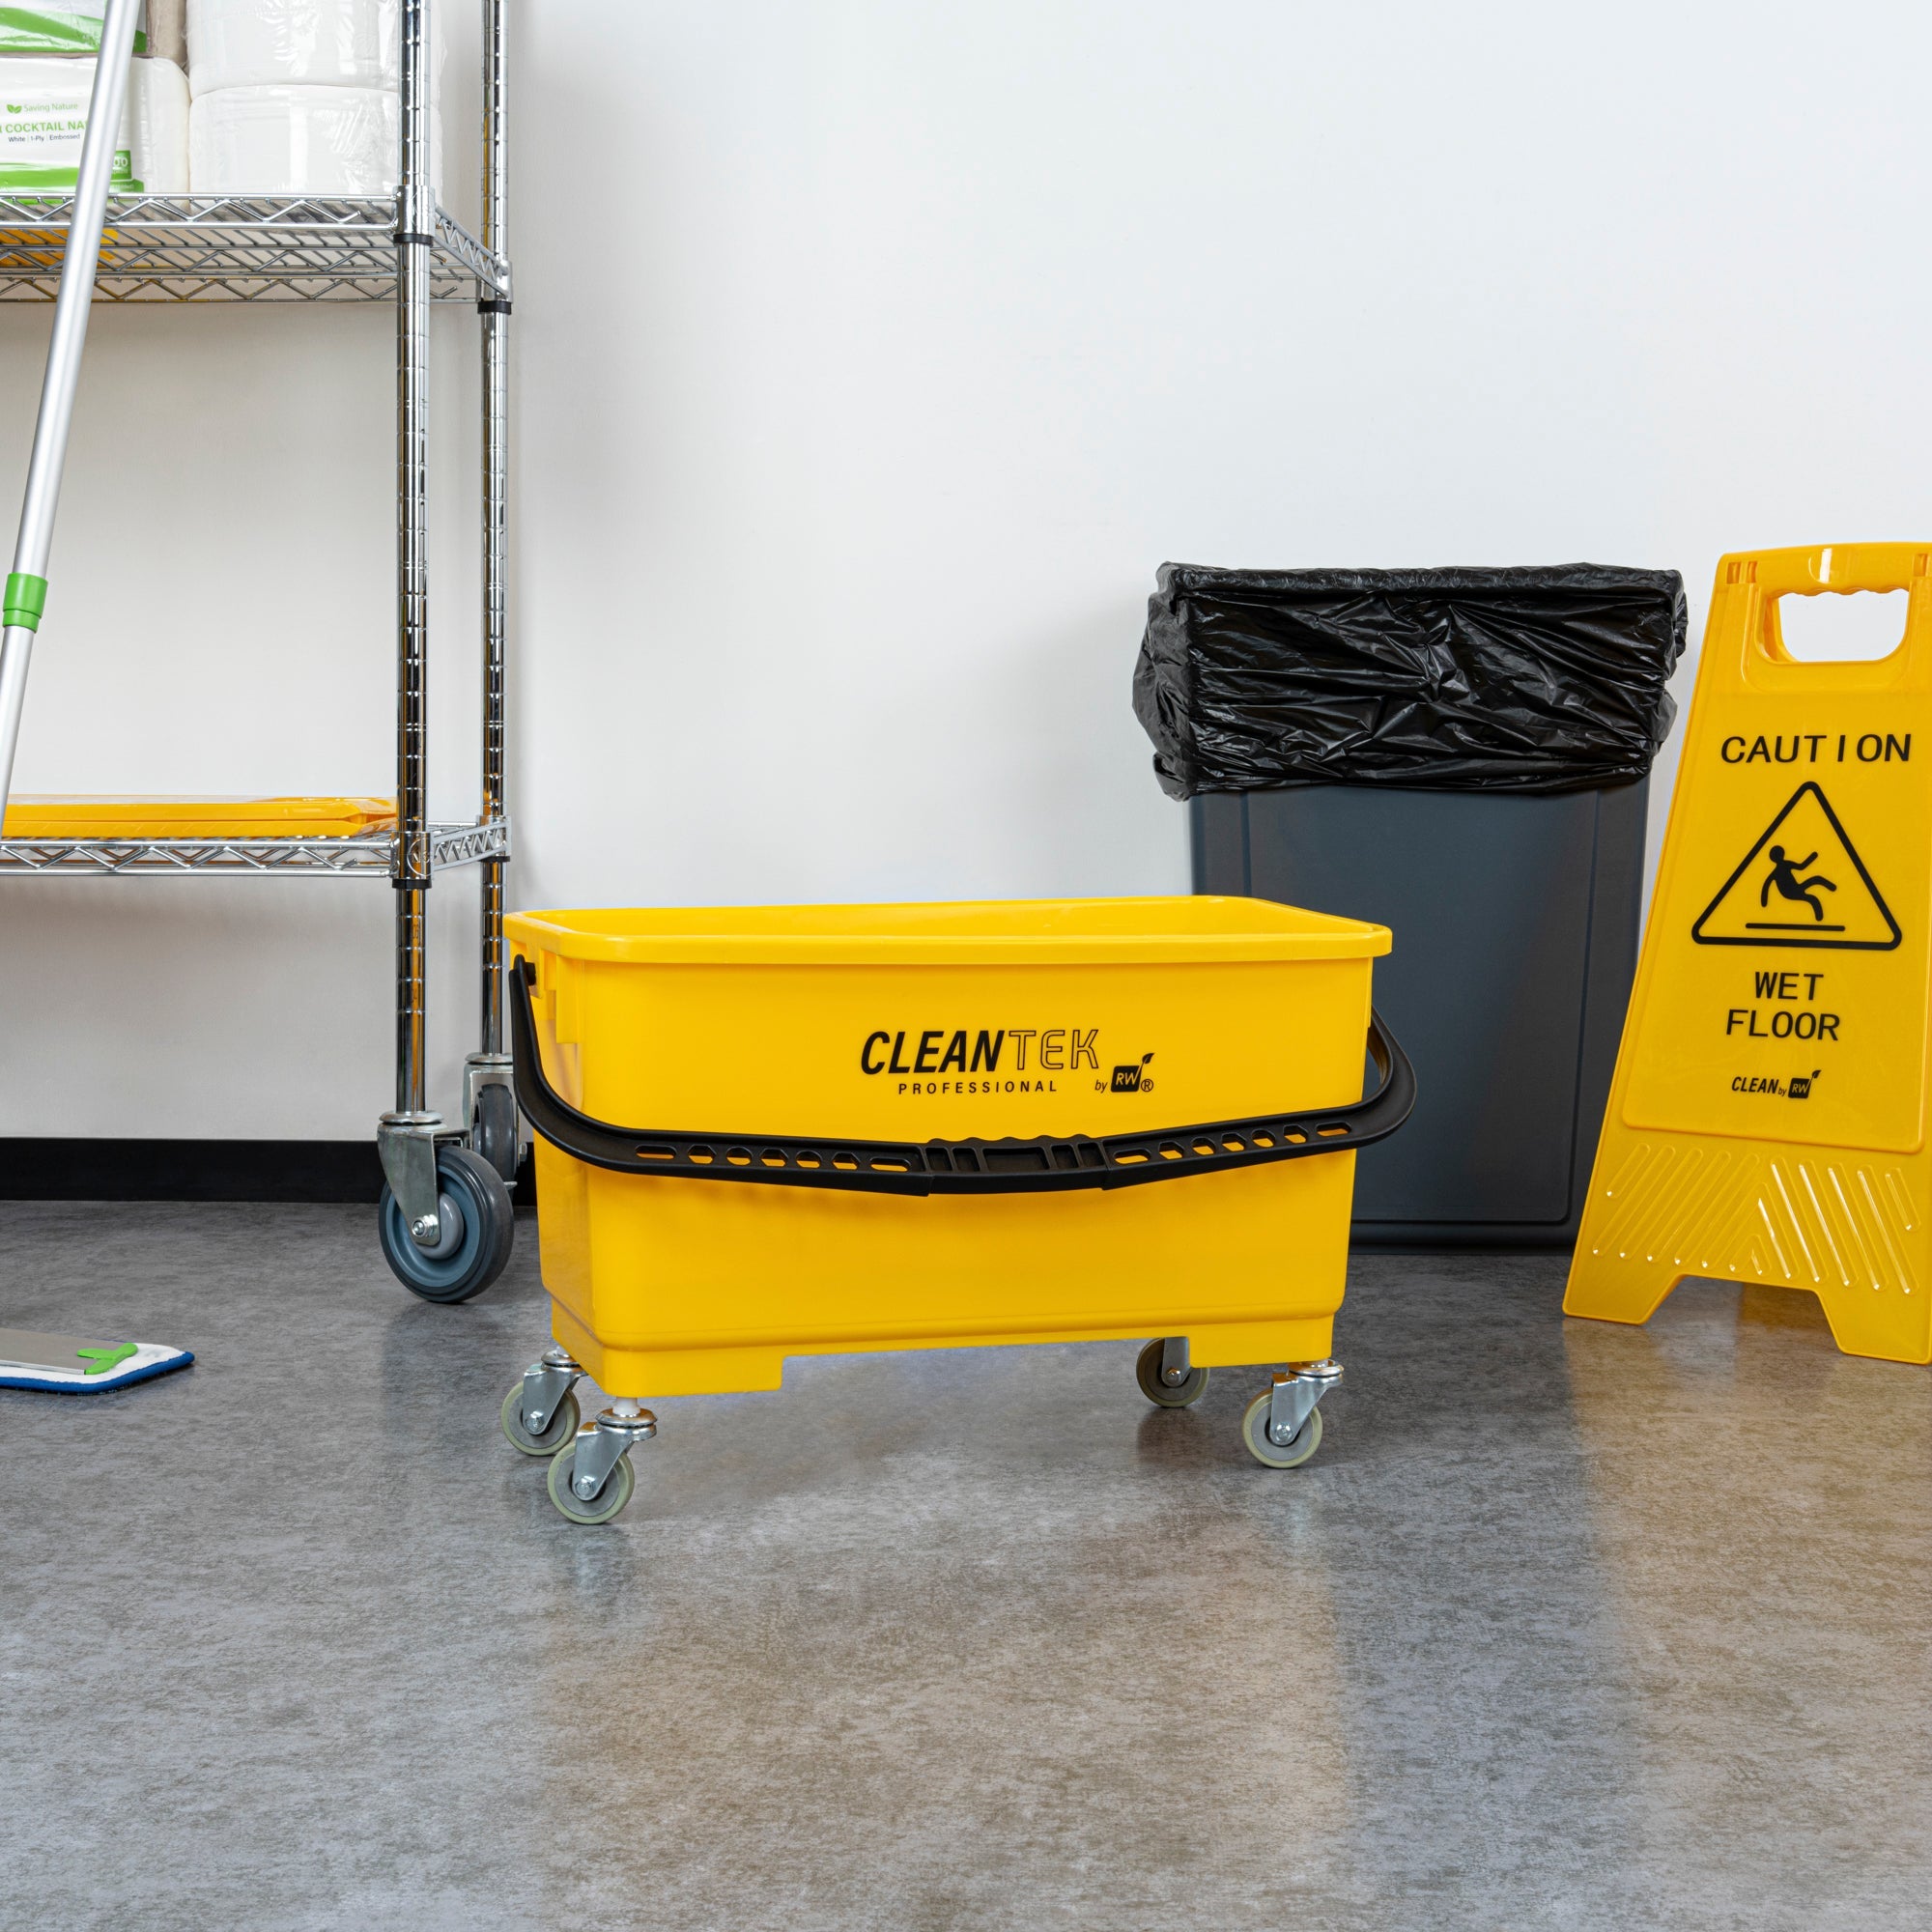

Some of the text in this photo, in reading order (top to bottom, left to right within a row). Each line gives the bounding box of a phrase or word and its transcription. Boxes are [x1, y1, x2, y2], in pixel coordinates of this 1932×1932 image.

[24, 102, 78, 113] Saving Nature
[5, 122, 65, 133] COCKTAIL
[68, 120, 87, 130] NA
[1720, 733, 1912, 764] CAUTION
[1754, 971, 1825, 1001] WET
[1725, 1009, 1841, 1041] FLOOR
[897, 1080, 1058, 1095] PROFESSIONAL
[1094, 1079, 1108, 1094] by
[1731, 1076, 1779, 1094] CLEAN
[1777, 1087, 1787, 1097] by
